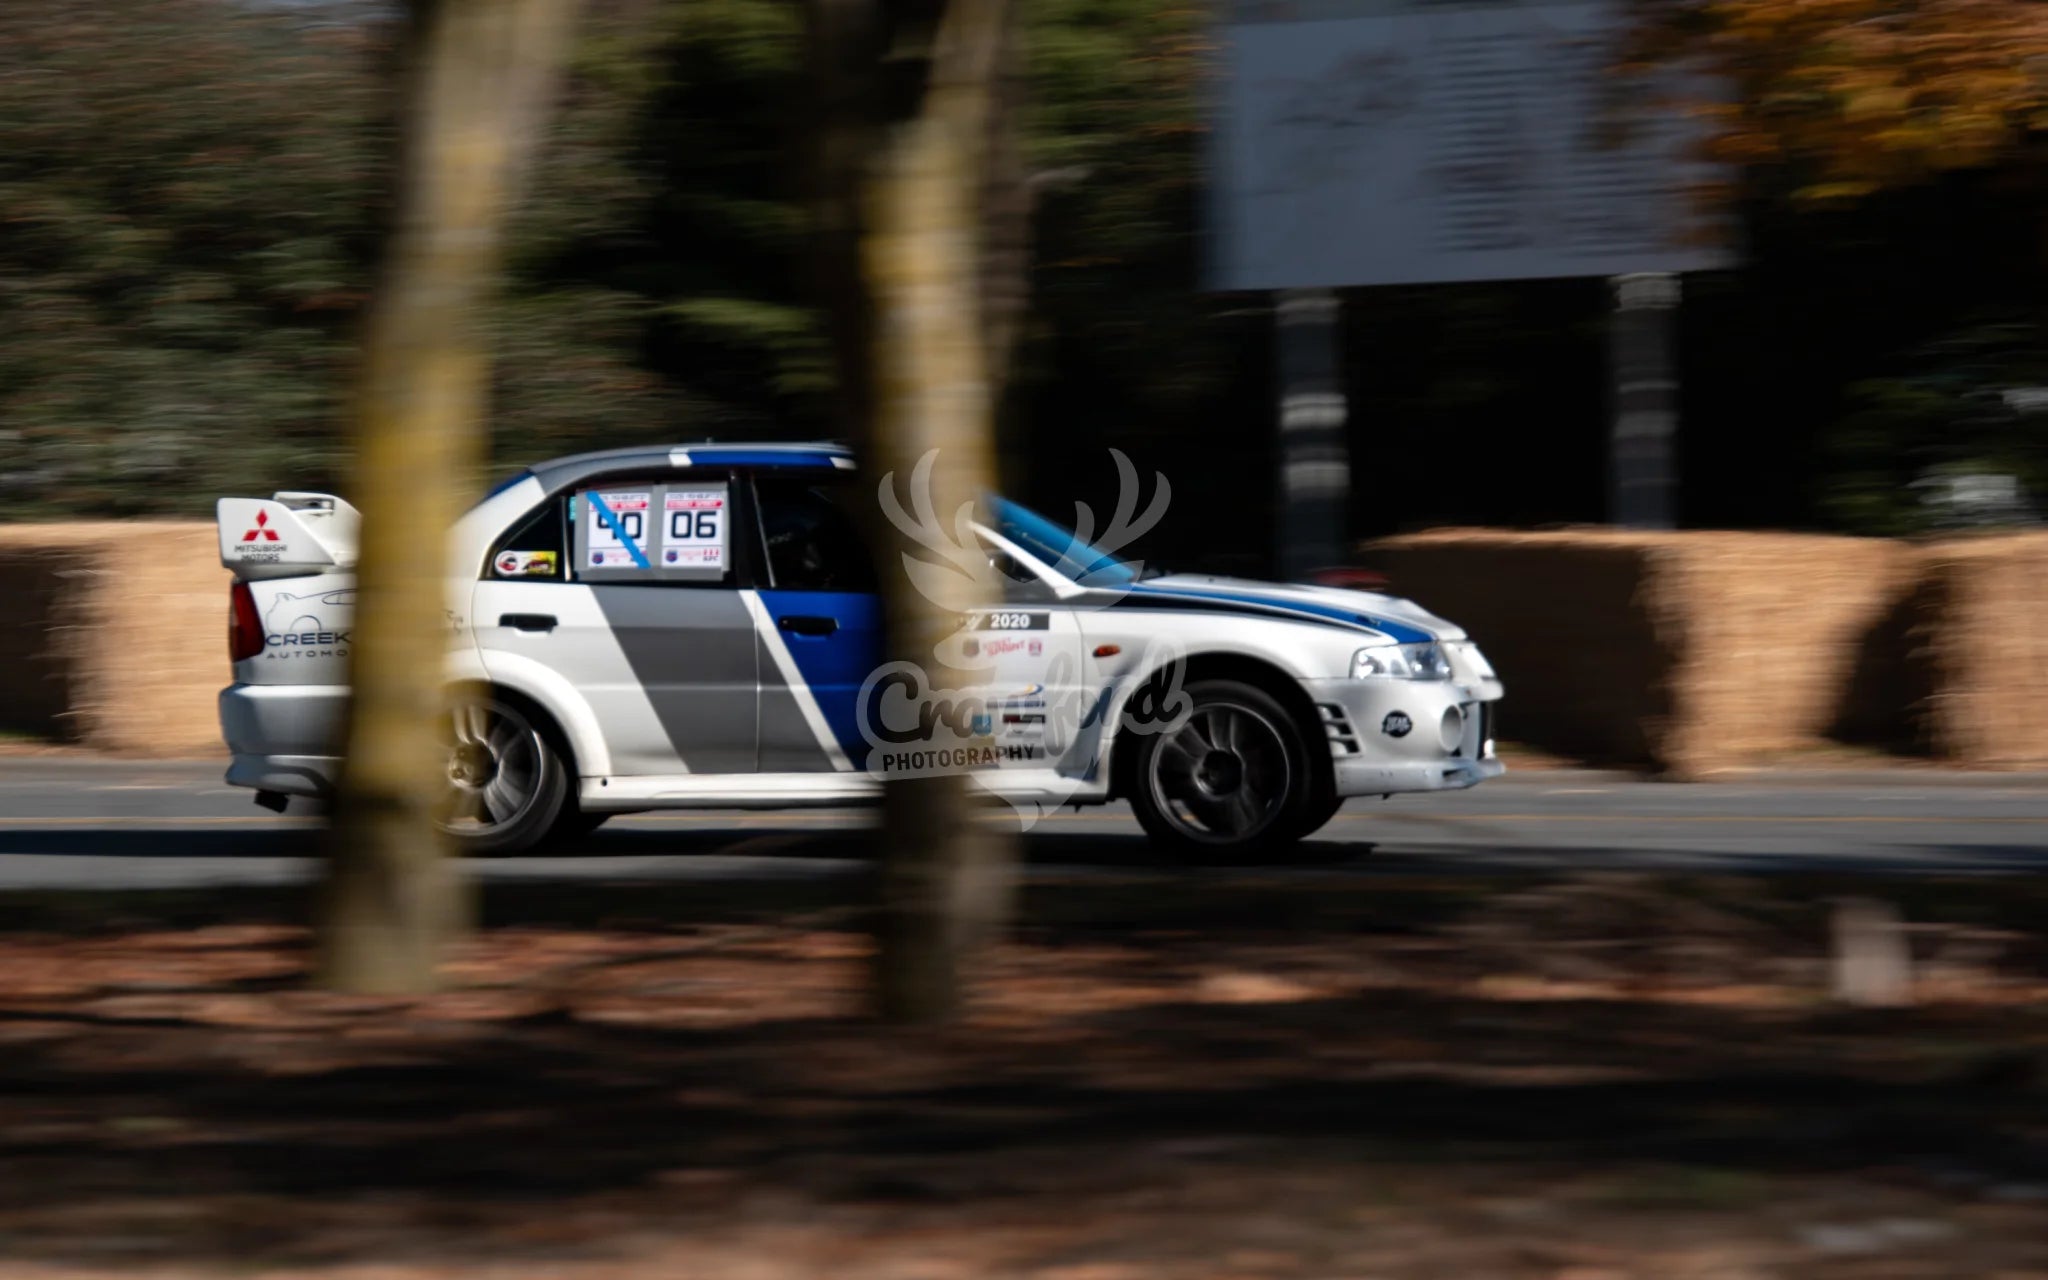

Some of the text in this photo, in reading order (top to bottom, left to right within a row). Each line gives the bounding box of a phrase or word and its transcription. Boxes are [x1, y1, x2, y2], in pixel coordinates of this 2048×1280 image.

[671, 511, 717, 539] 06
[241, 554, 280, 562] MOTORS
[990, 614, 1031, 628] 2020
[266, 632, 352, 646] CREEK
